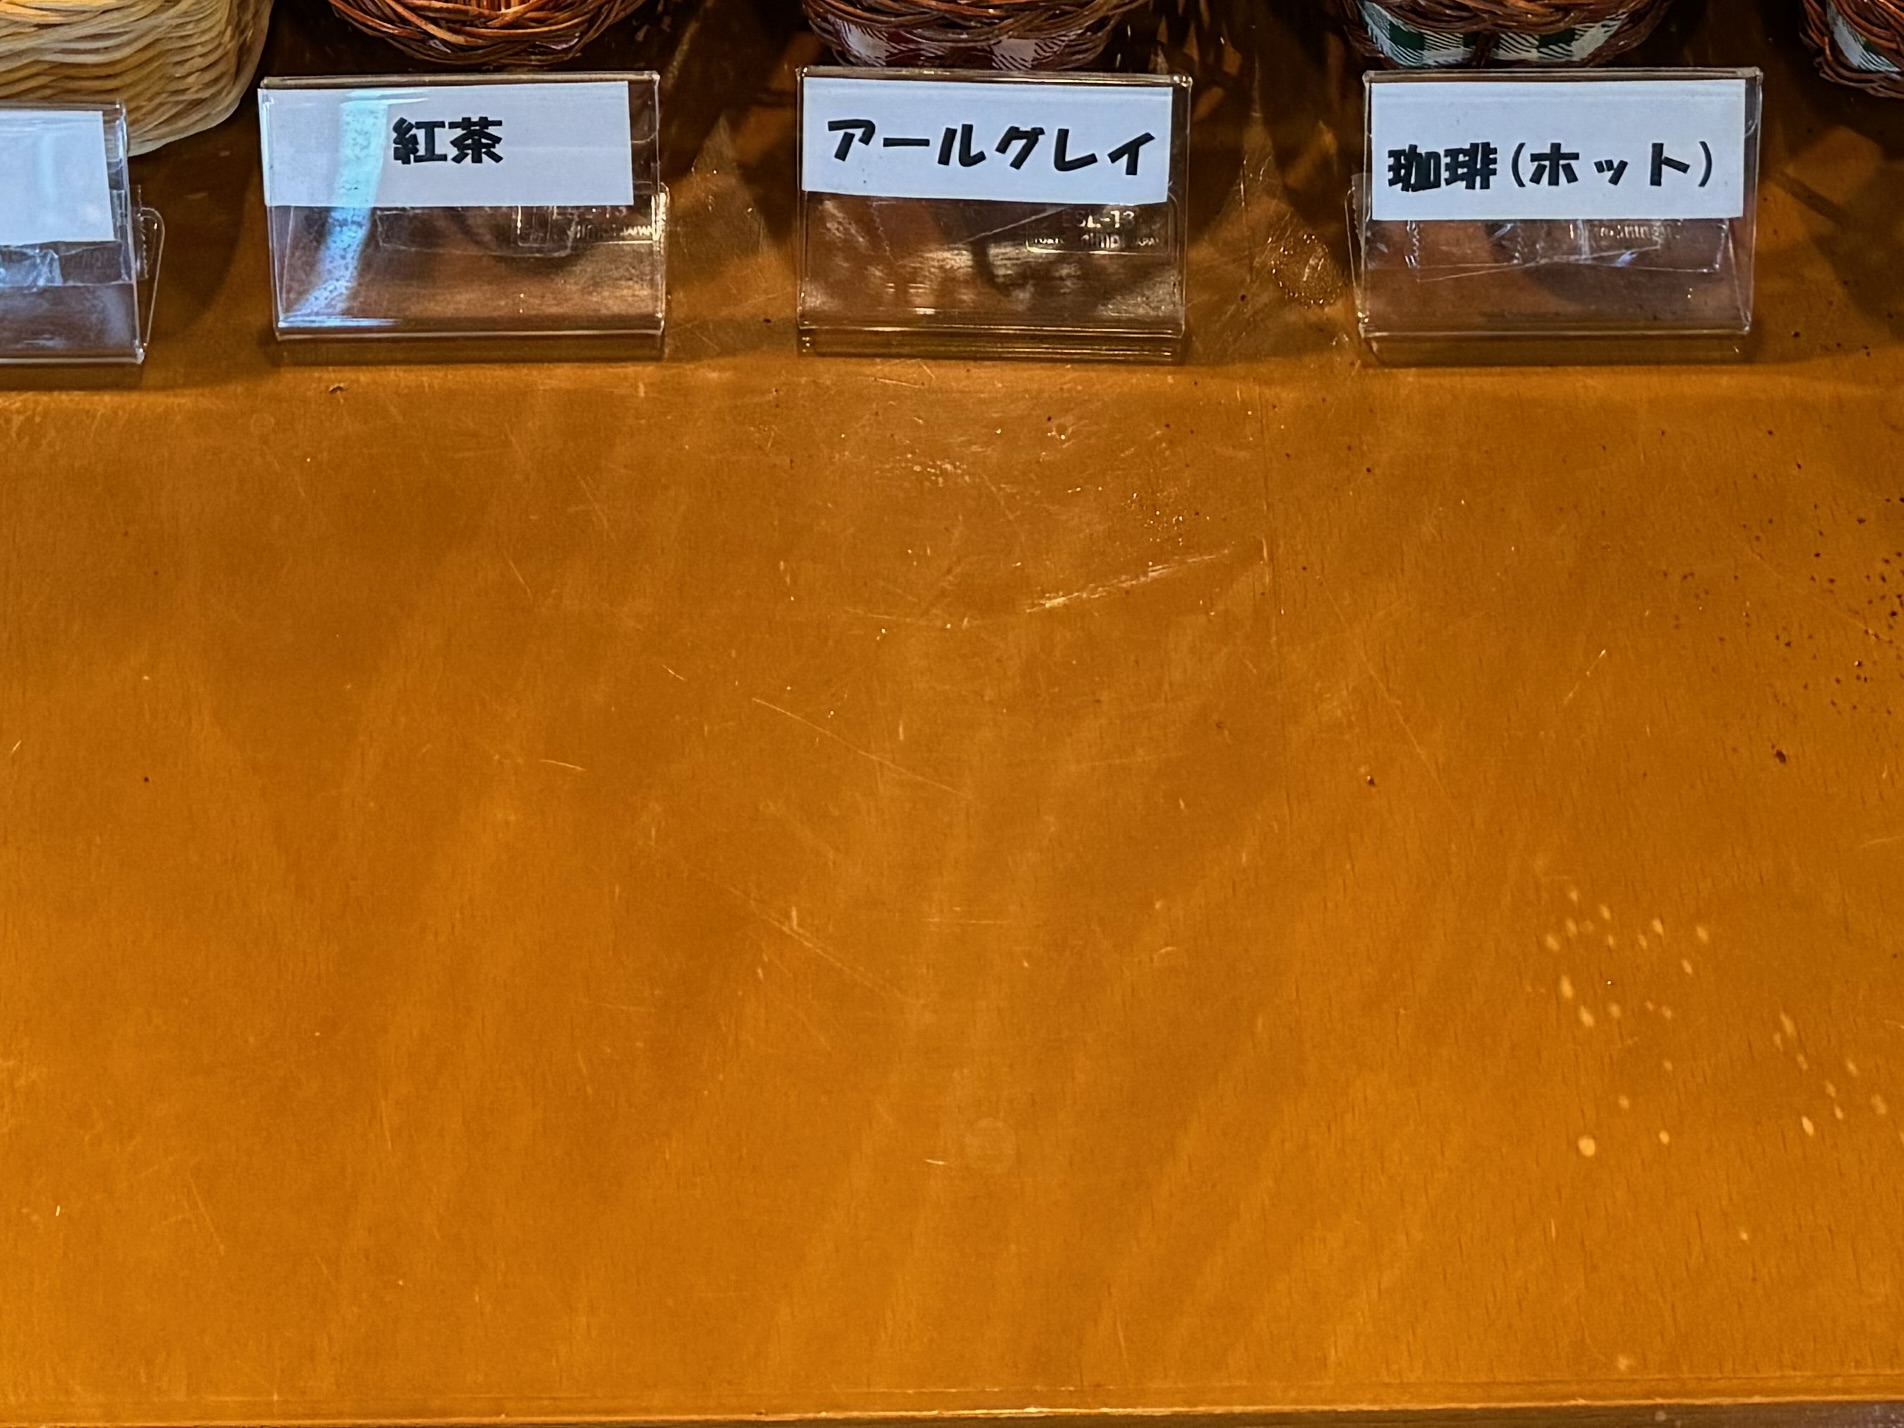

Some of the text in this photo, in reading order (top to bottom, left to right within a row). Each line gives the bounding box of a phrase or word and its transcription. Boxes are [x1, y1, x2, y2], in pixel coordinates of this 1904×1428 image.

[391, 115, 504, 167] 紅茶
[827, 117, 1158, 178] アールグレイ
[1387, 137, 1716, 194] 珈琲(ホット)
